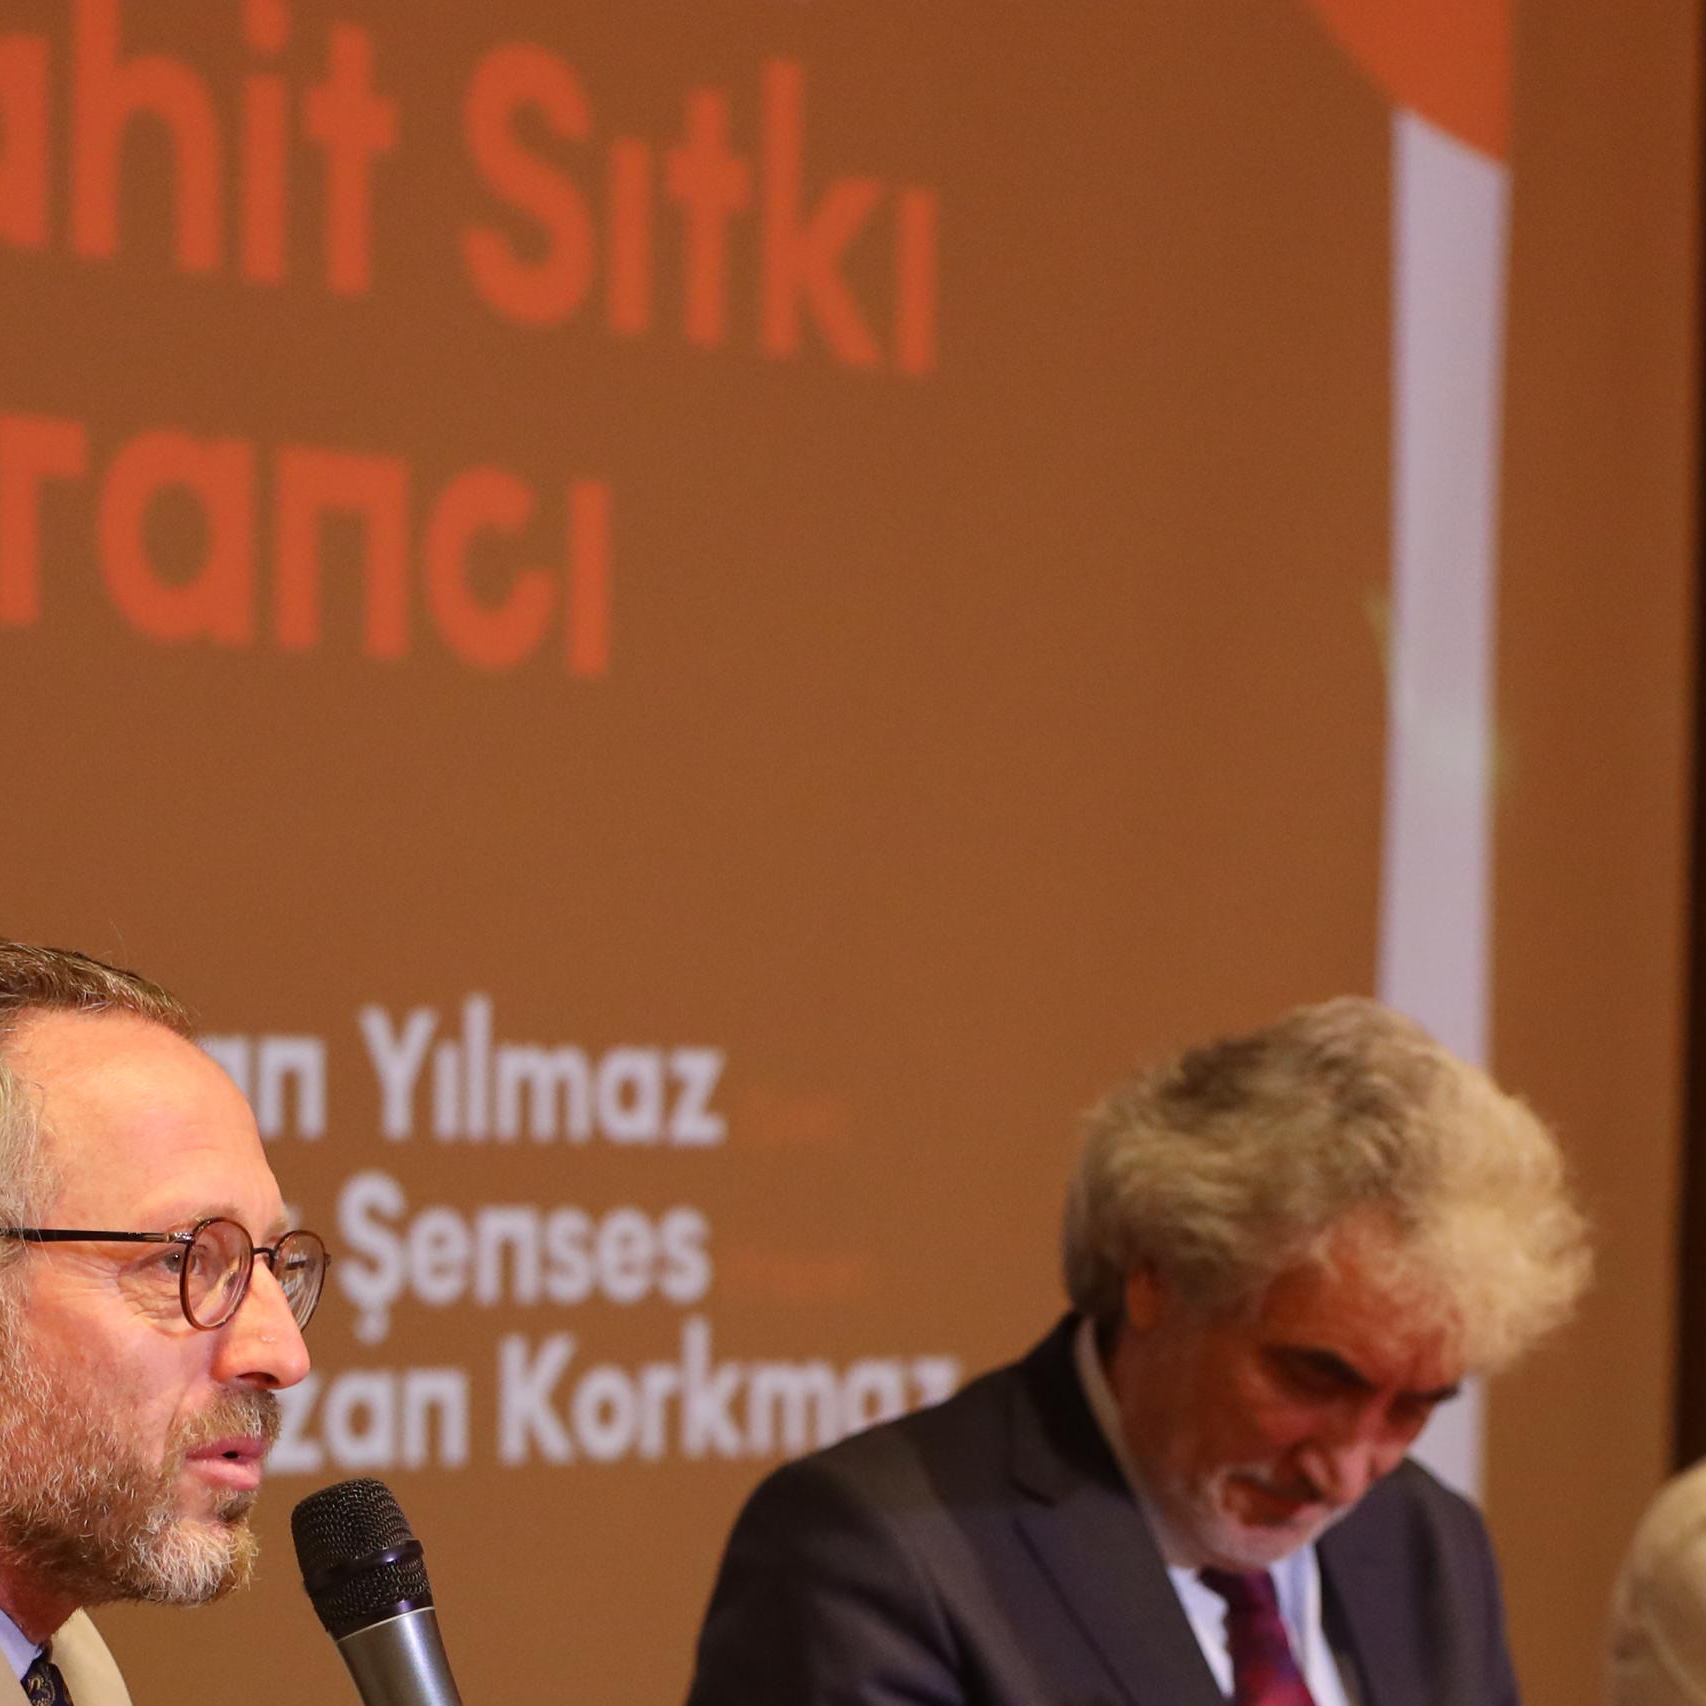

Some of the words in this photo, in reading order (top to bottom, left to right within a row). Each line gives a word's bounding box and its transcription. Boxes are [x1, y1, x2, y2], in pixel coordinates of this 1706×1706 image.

[461, 43, 939, 376] Sıtkı
[358, 996, 727, 1147] Yılmaz
[337, 1171, 712, 1344] Şenses
